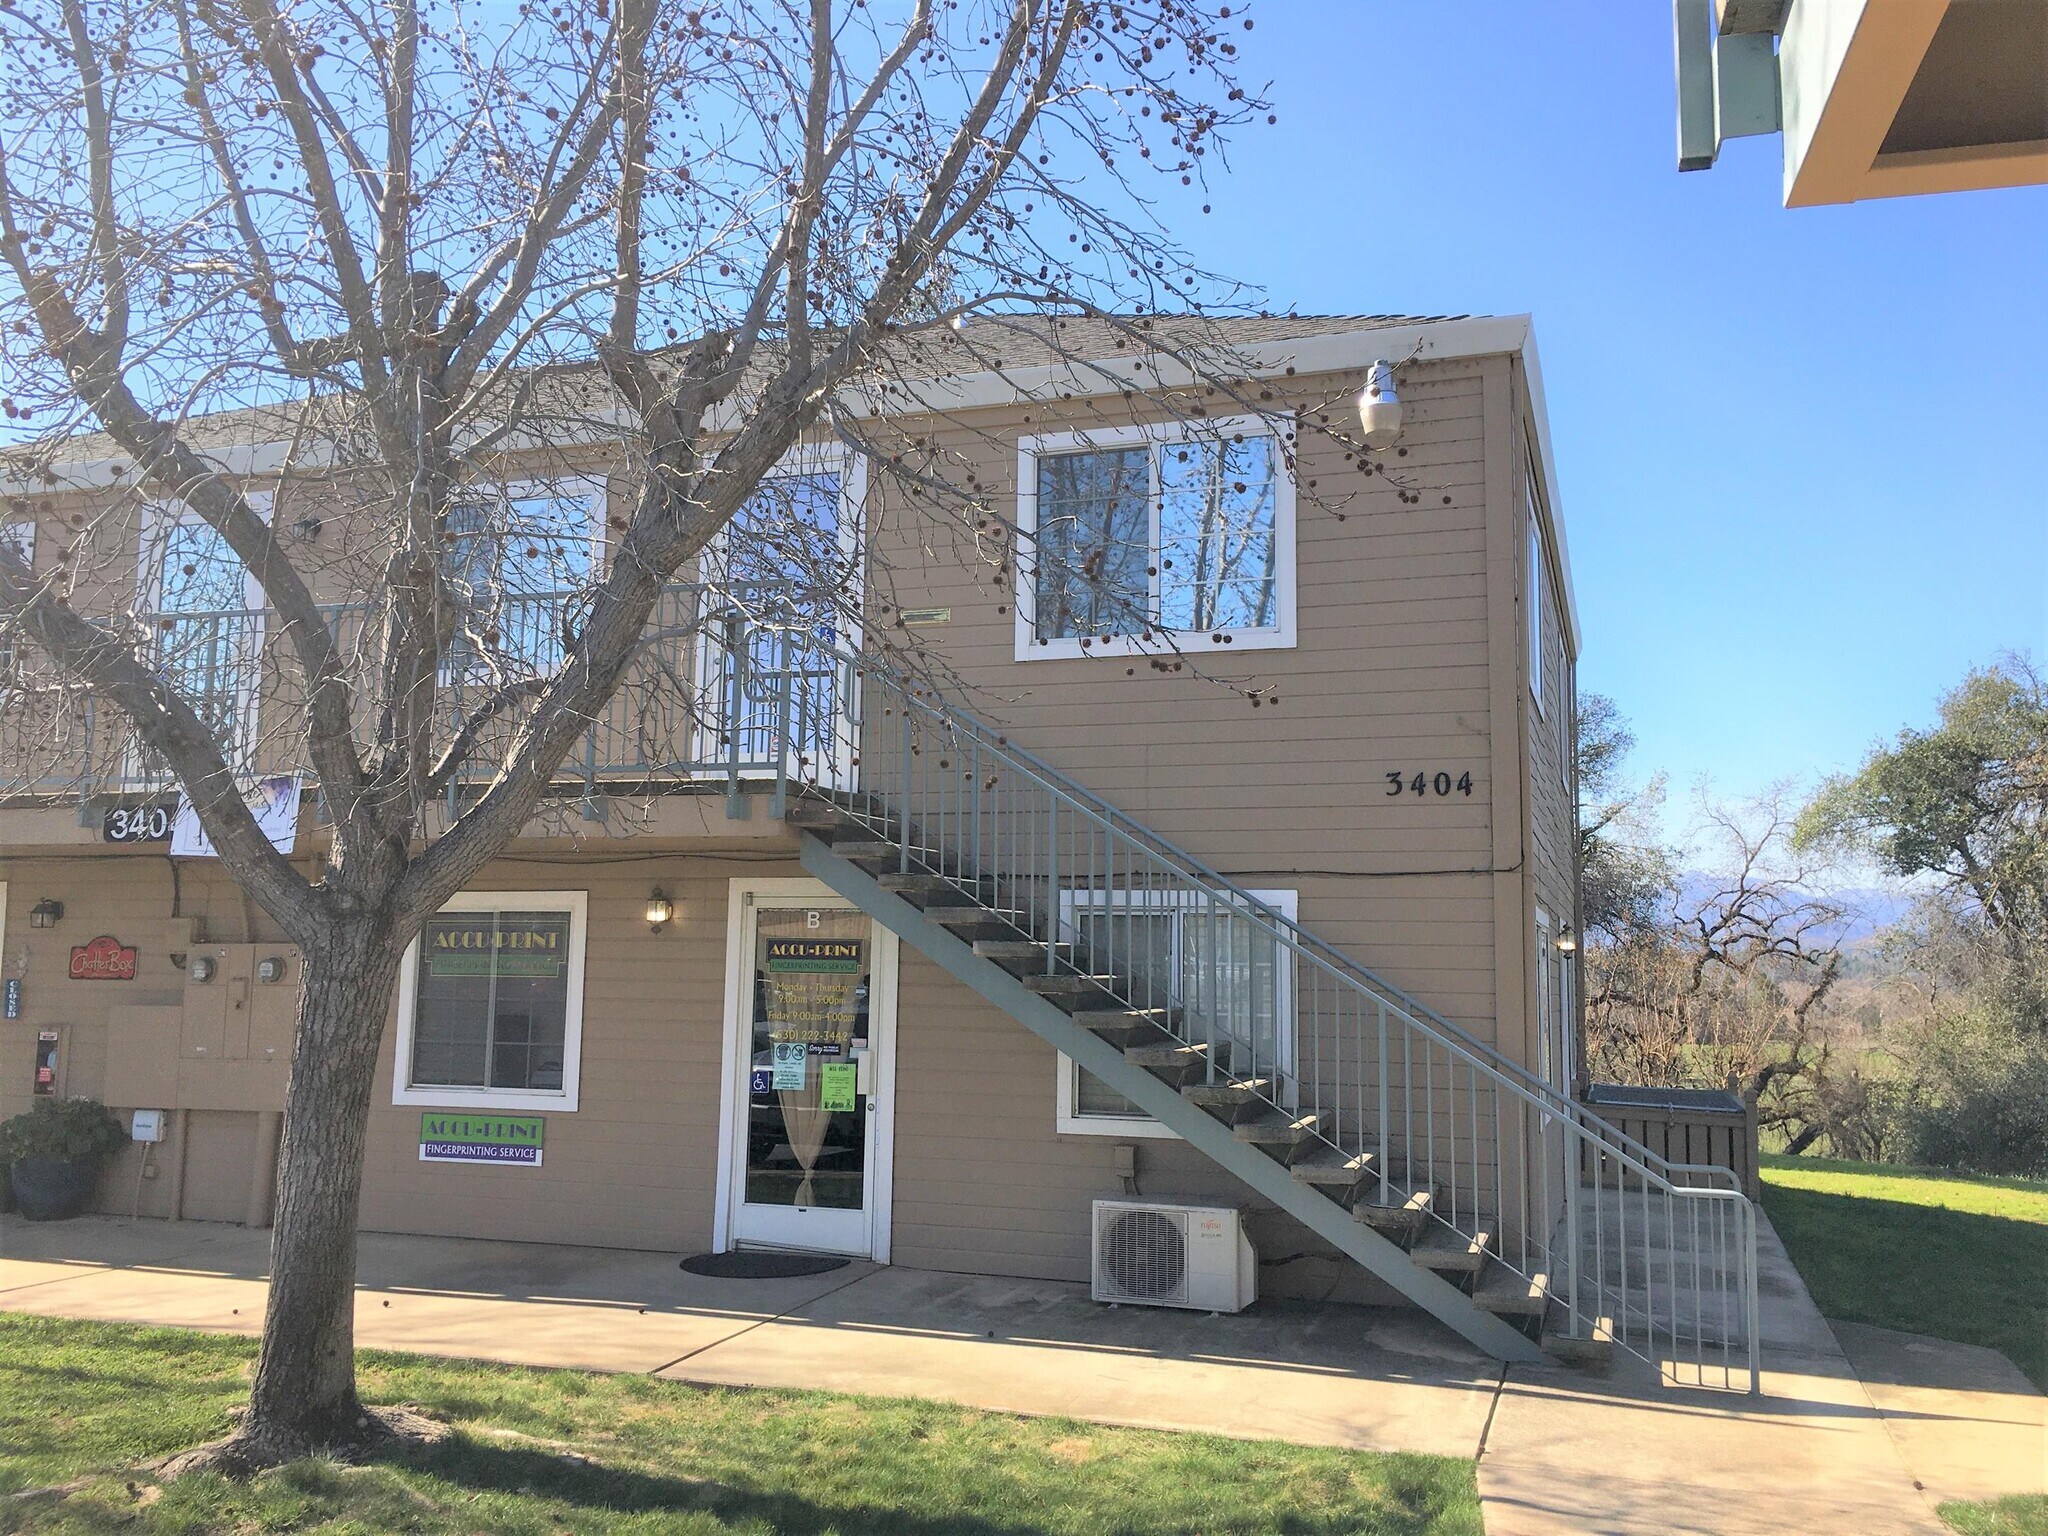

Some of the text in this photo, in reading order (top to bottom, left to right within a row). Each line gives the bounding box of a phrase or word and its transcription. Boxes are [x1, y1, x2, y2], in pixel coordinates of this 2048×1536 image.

[1385, 770, 1473, 797] 3404
[110, 809, 173, 840] 340
[807, 911, 821, 929] B
[769, 944, 859, 957] ACCU-PRINT
[828, 961, 856, 971] SERVICE
[776, 983, 807, 992] Monday
[815, 983, 849, 993] Thursday
[768, 1010, 790, 1021] Friday
[801, 1030, 848, 1042] 222-3442
[426, 1143, 535, 1159] FINGERPRINTING SERVICE
